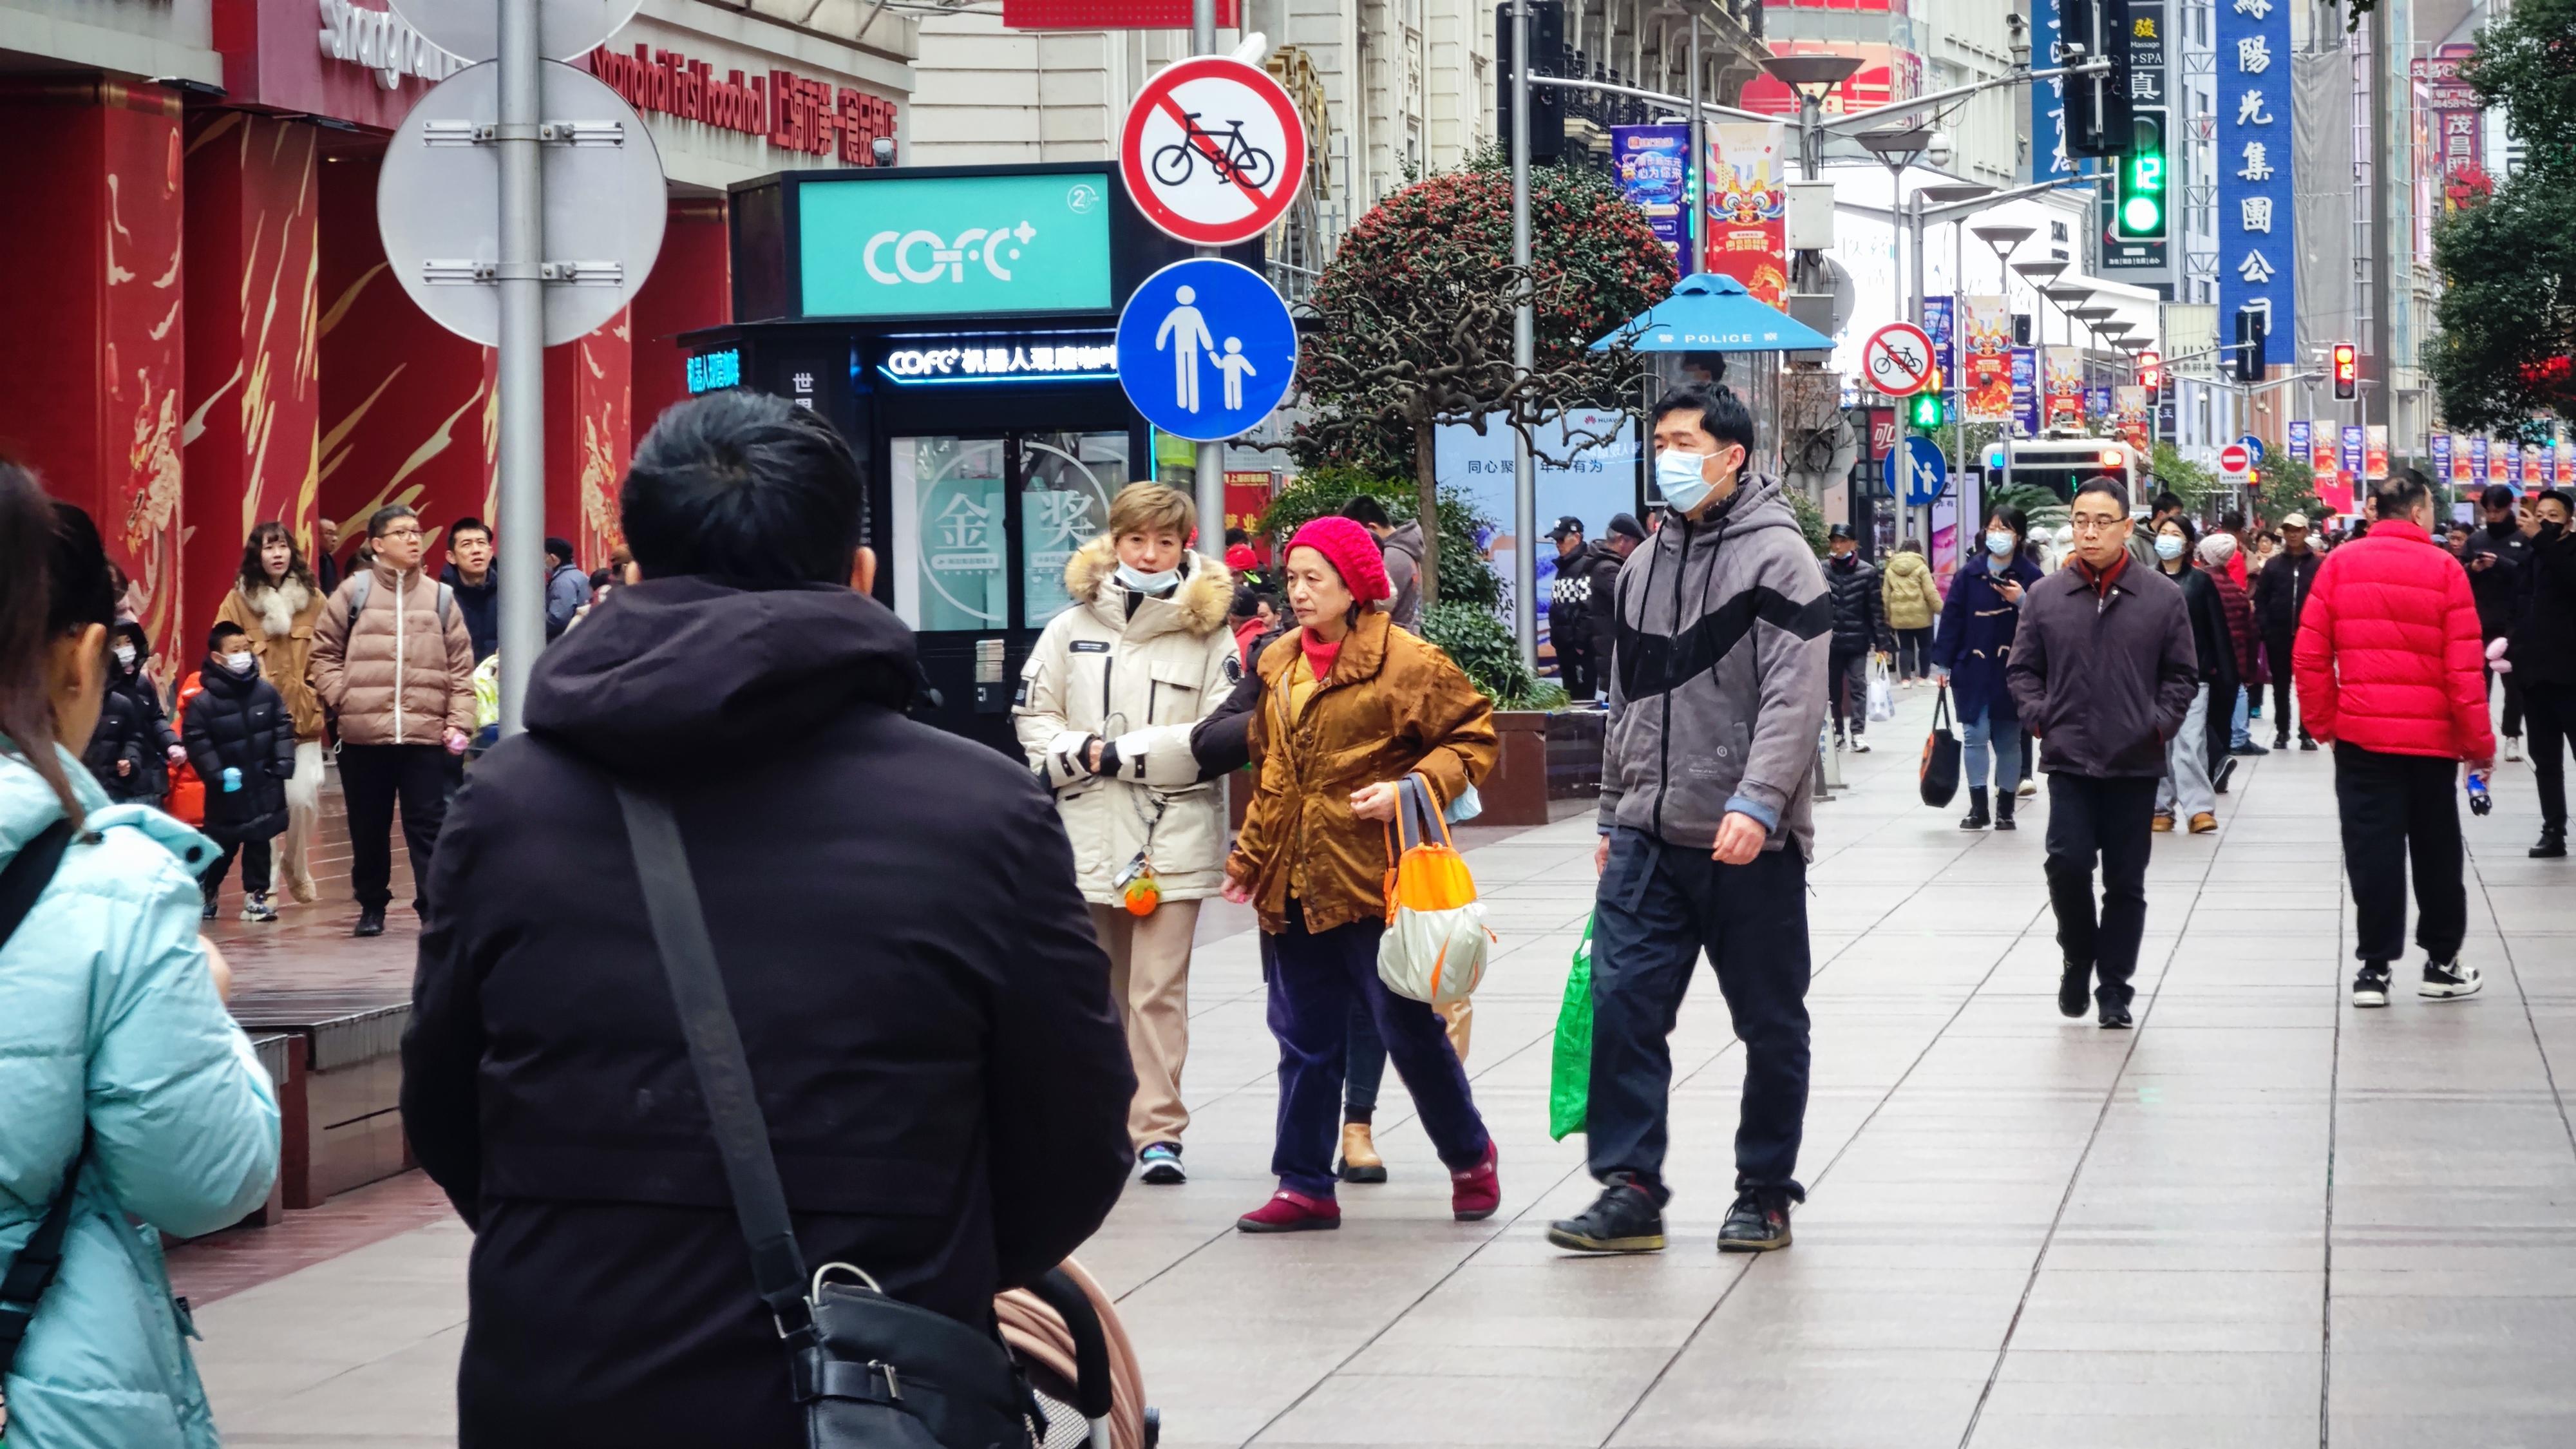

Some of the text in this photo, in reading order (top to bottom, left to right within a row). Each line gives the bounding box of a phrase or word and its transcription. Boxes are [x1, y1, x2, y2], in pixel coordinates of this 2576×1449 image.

[668, 53, 702, 121] First
[768, 70, 898, 167] 上海市第一食品商店
[2135, 158, 2161, 190] 12
[1685, 333, 1753, 343] POLICE
[934, 489, 1097, 549] 金 奖
